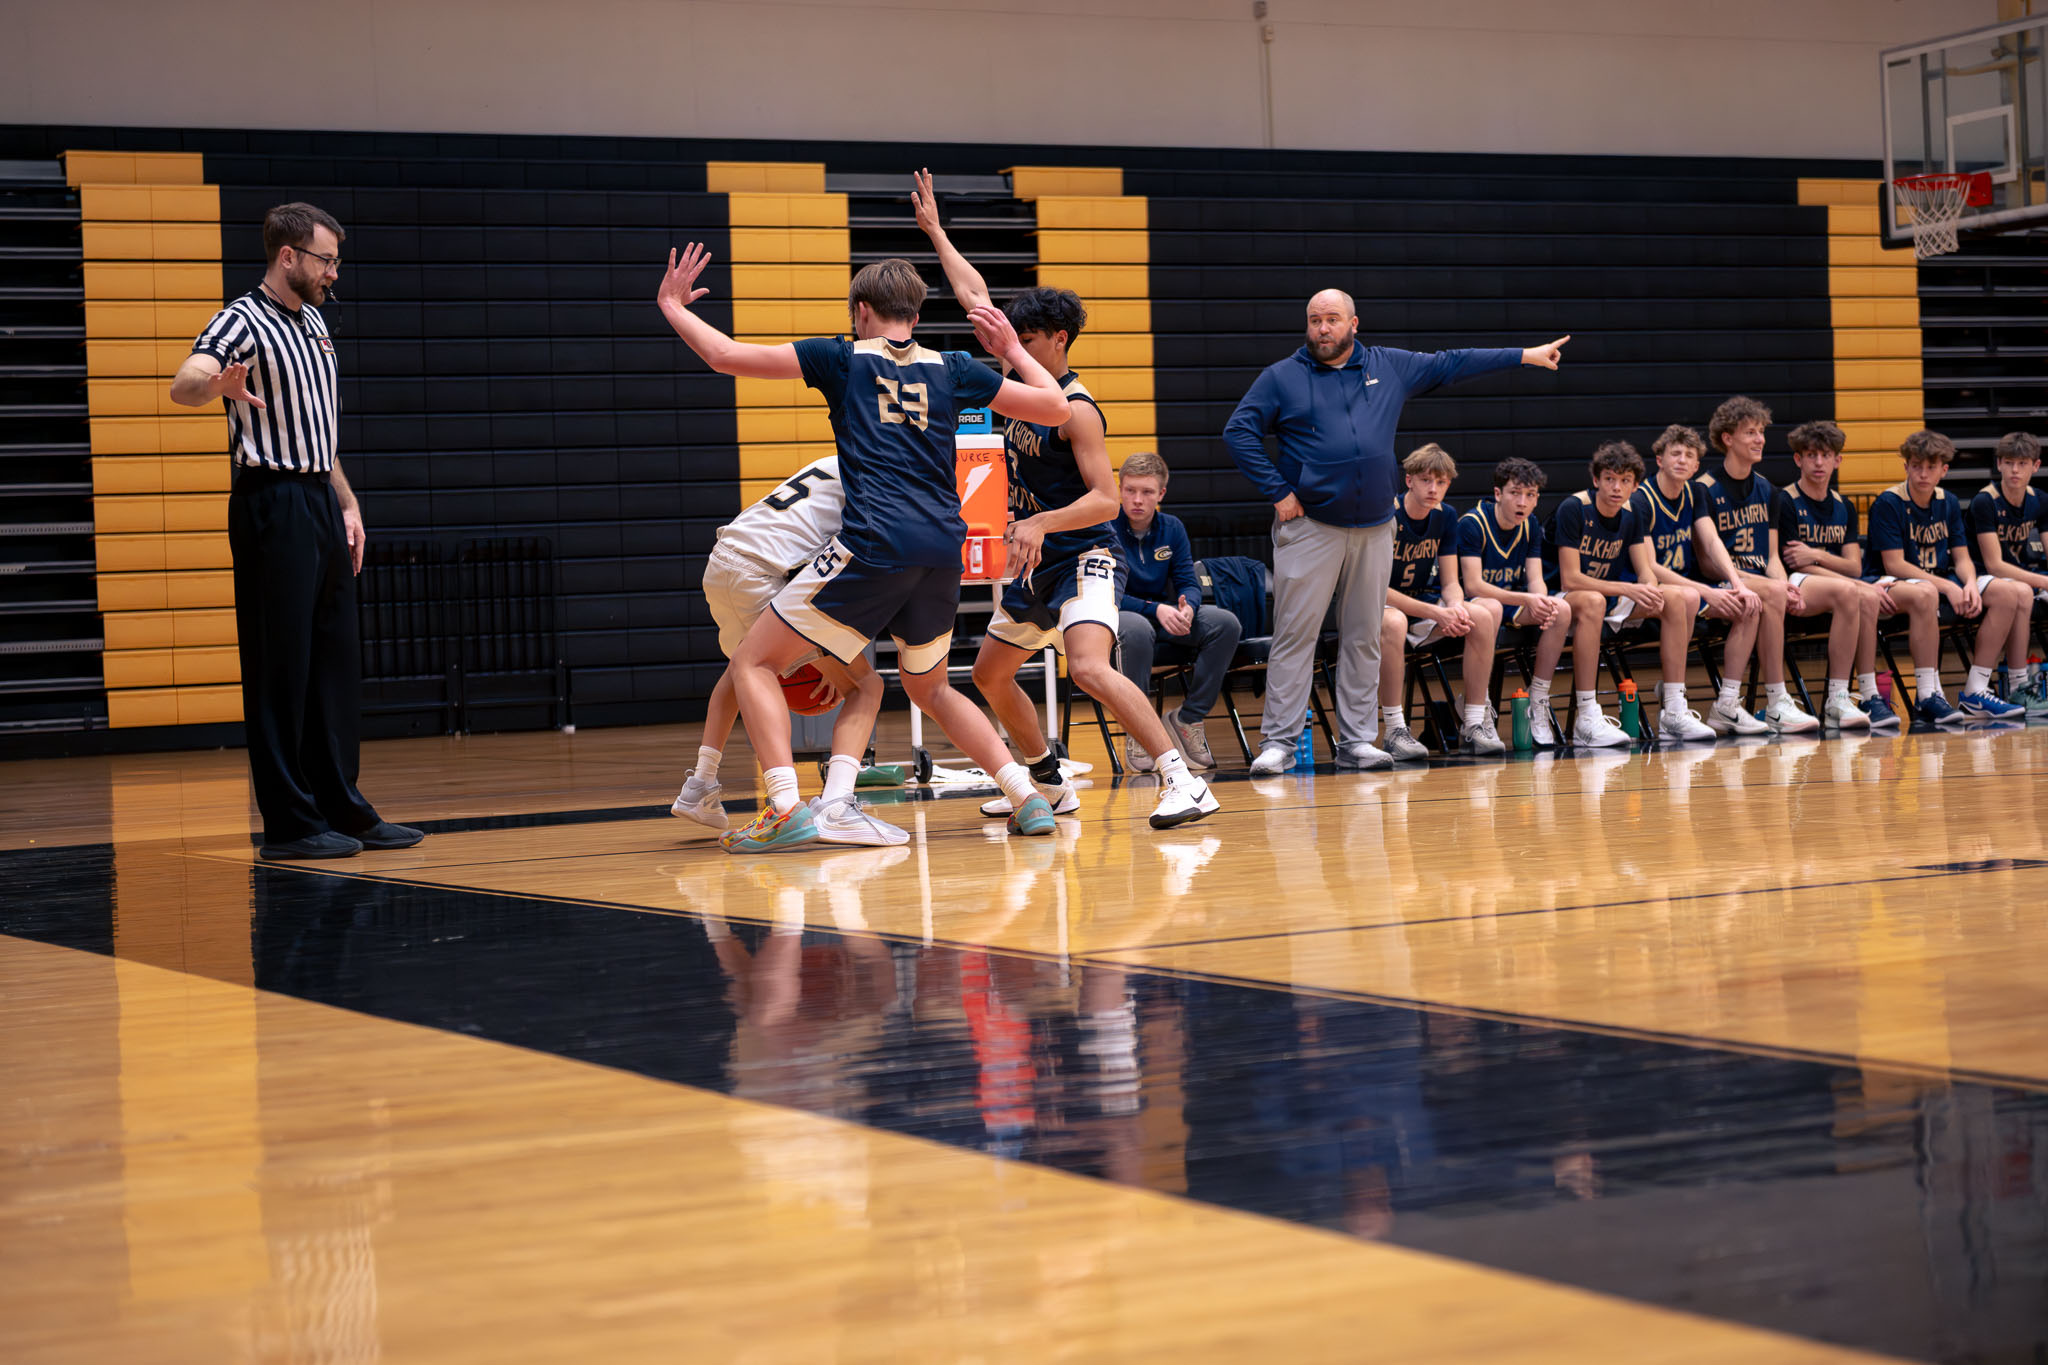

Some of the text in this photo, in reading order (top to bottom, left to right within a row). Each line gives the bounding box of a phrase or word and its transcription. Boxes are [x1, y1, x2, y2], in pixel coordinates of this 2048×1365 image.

[875, 375, 929, 432] 23
[958, 414, 984, 423] RADE
[762, 466, 837, 512] 5
[1084, 558, 1111, 580] ES
[1399, 563, 1416, 588] 5
